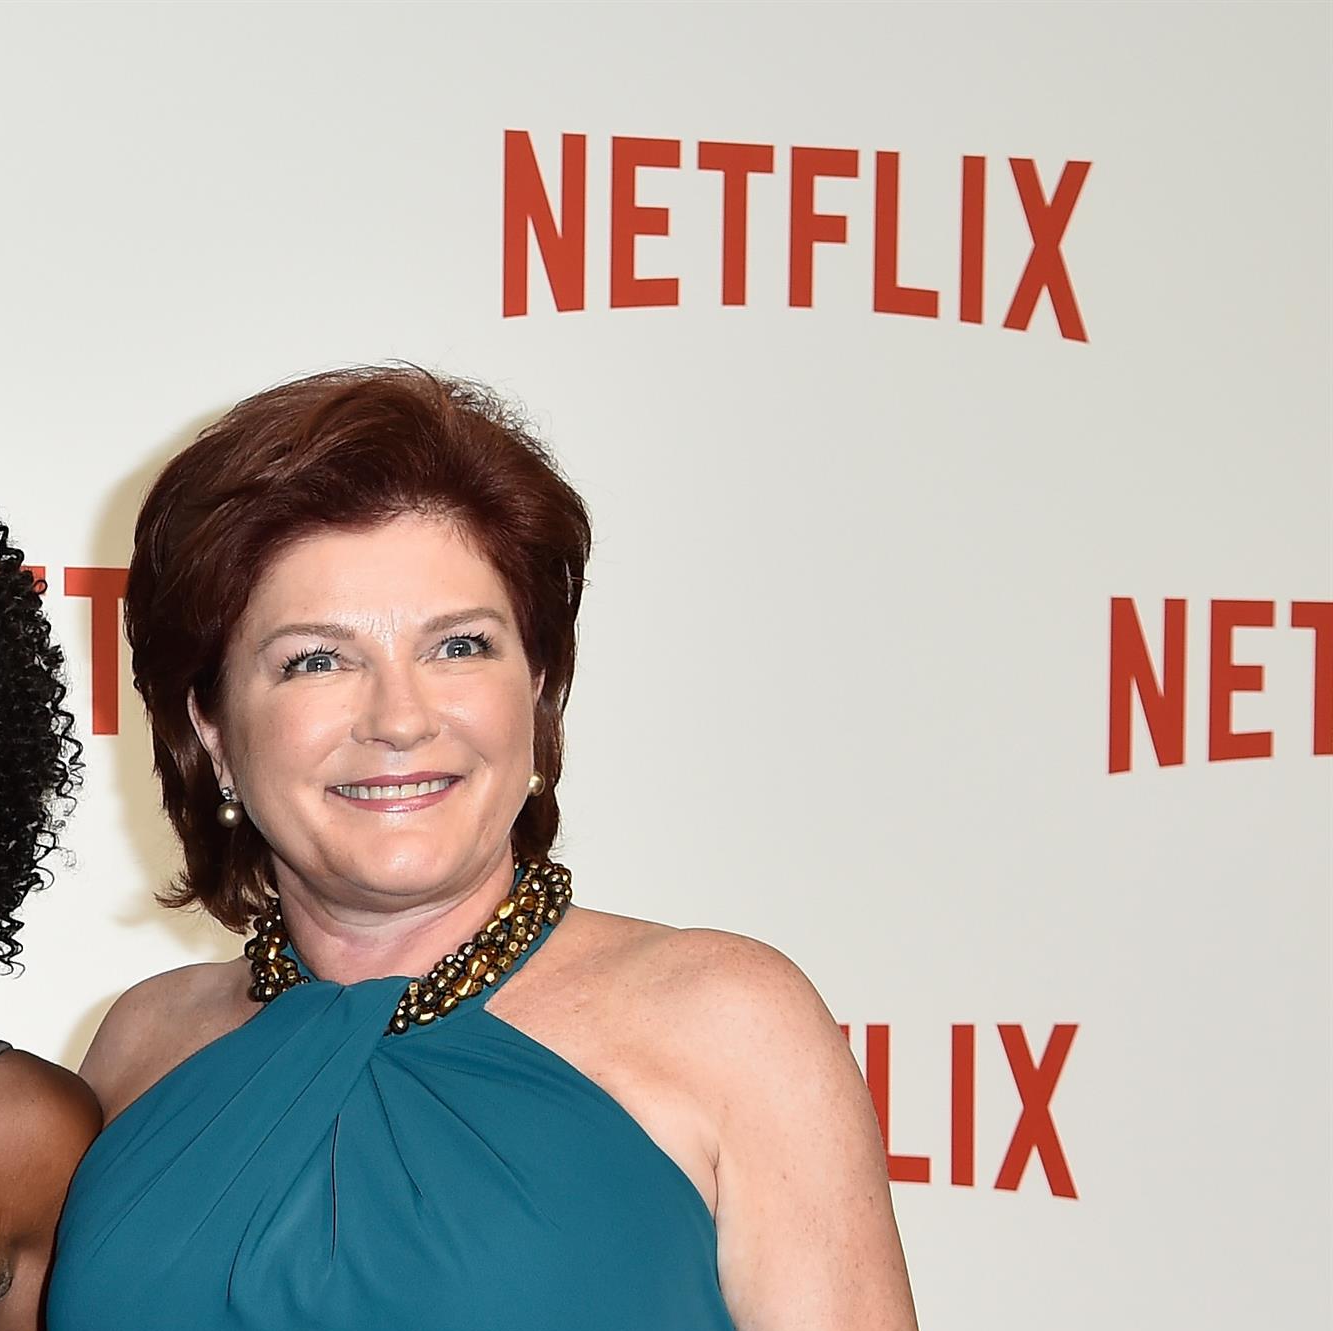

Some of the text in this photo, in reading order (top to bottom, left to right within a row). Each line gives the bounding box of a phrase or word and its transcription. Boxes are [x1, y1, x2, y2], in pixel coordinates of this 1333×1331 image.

[502, 129, 1092, 343] NETFLIX
[21, 565, 130, 736] T
[838, 1024, 1079, 1200] LIX
